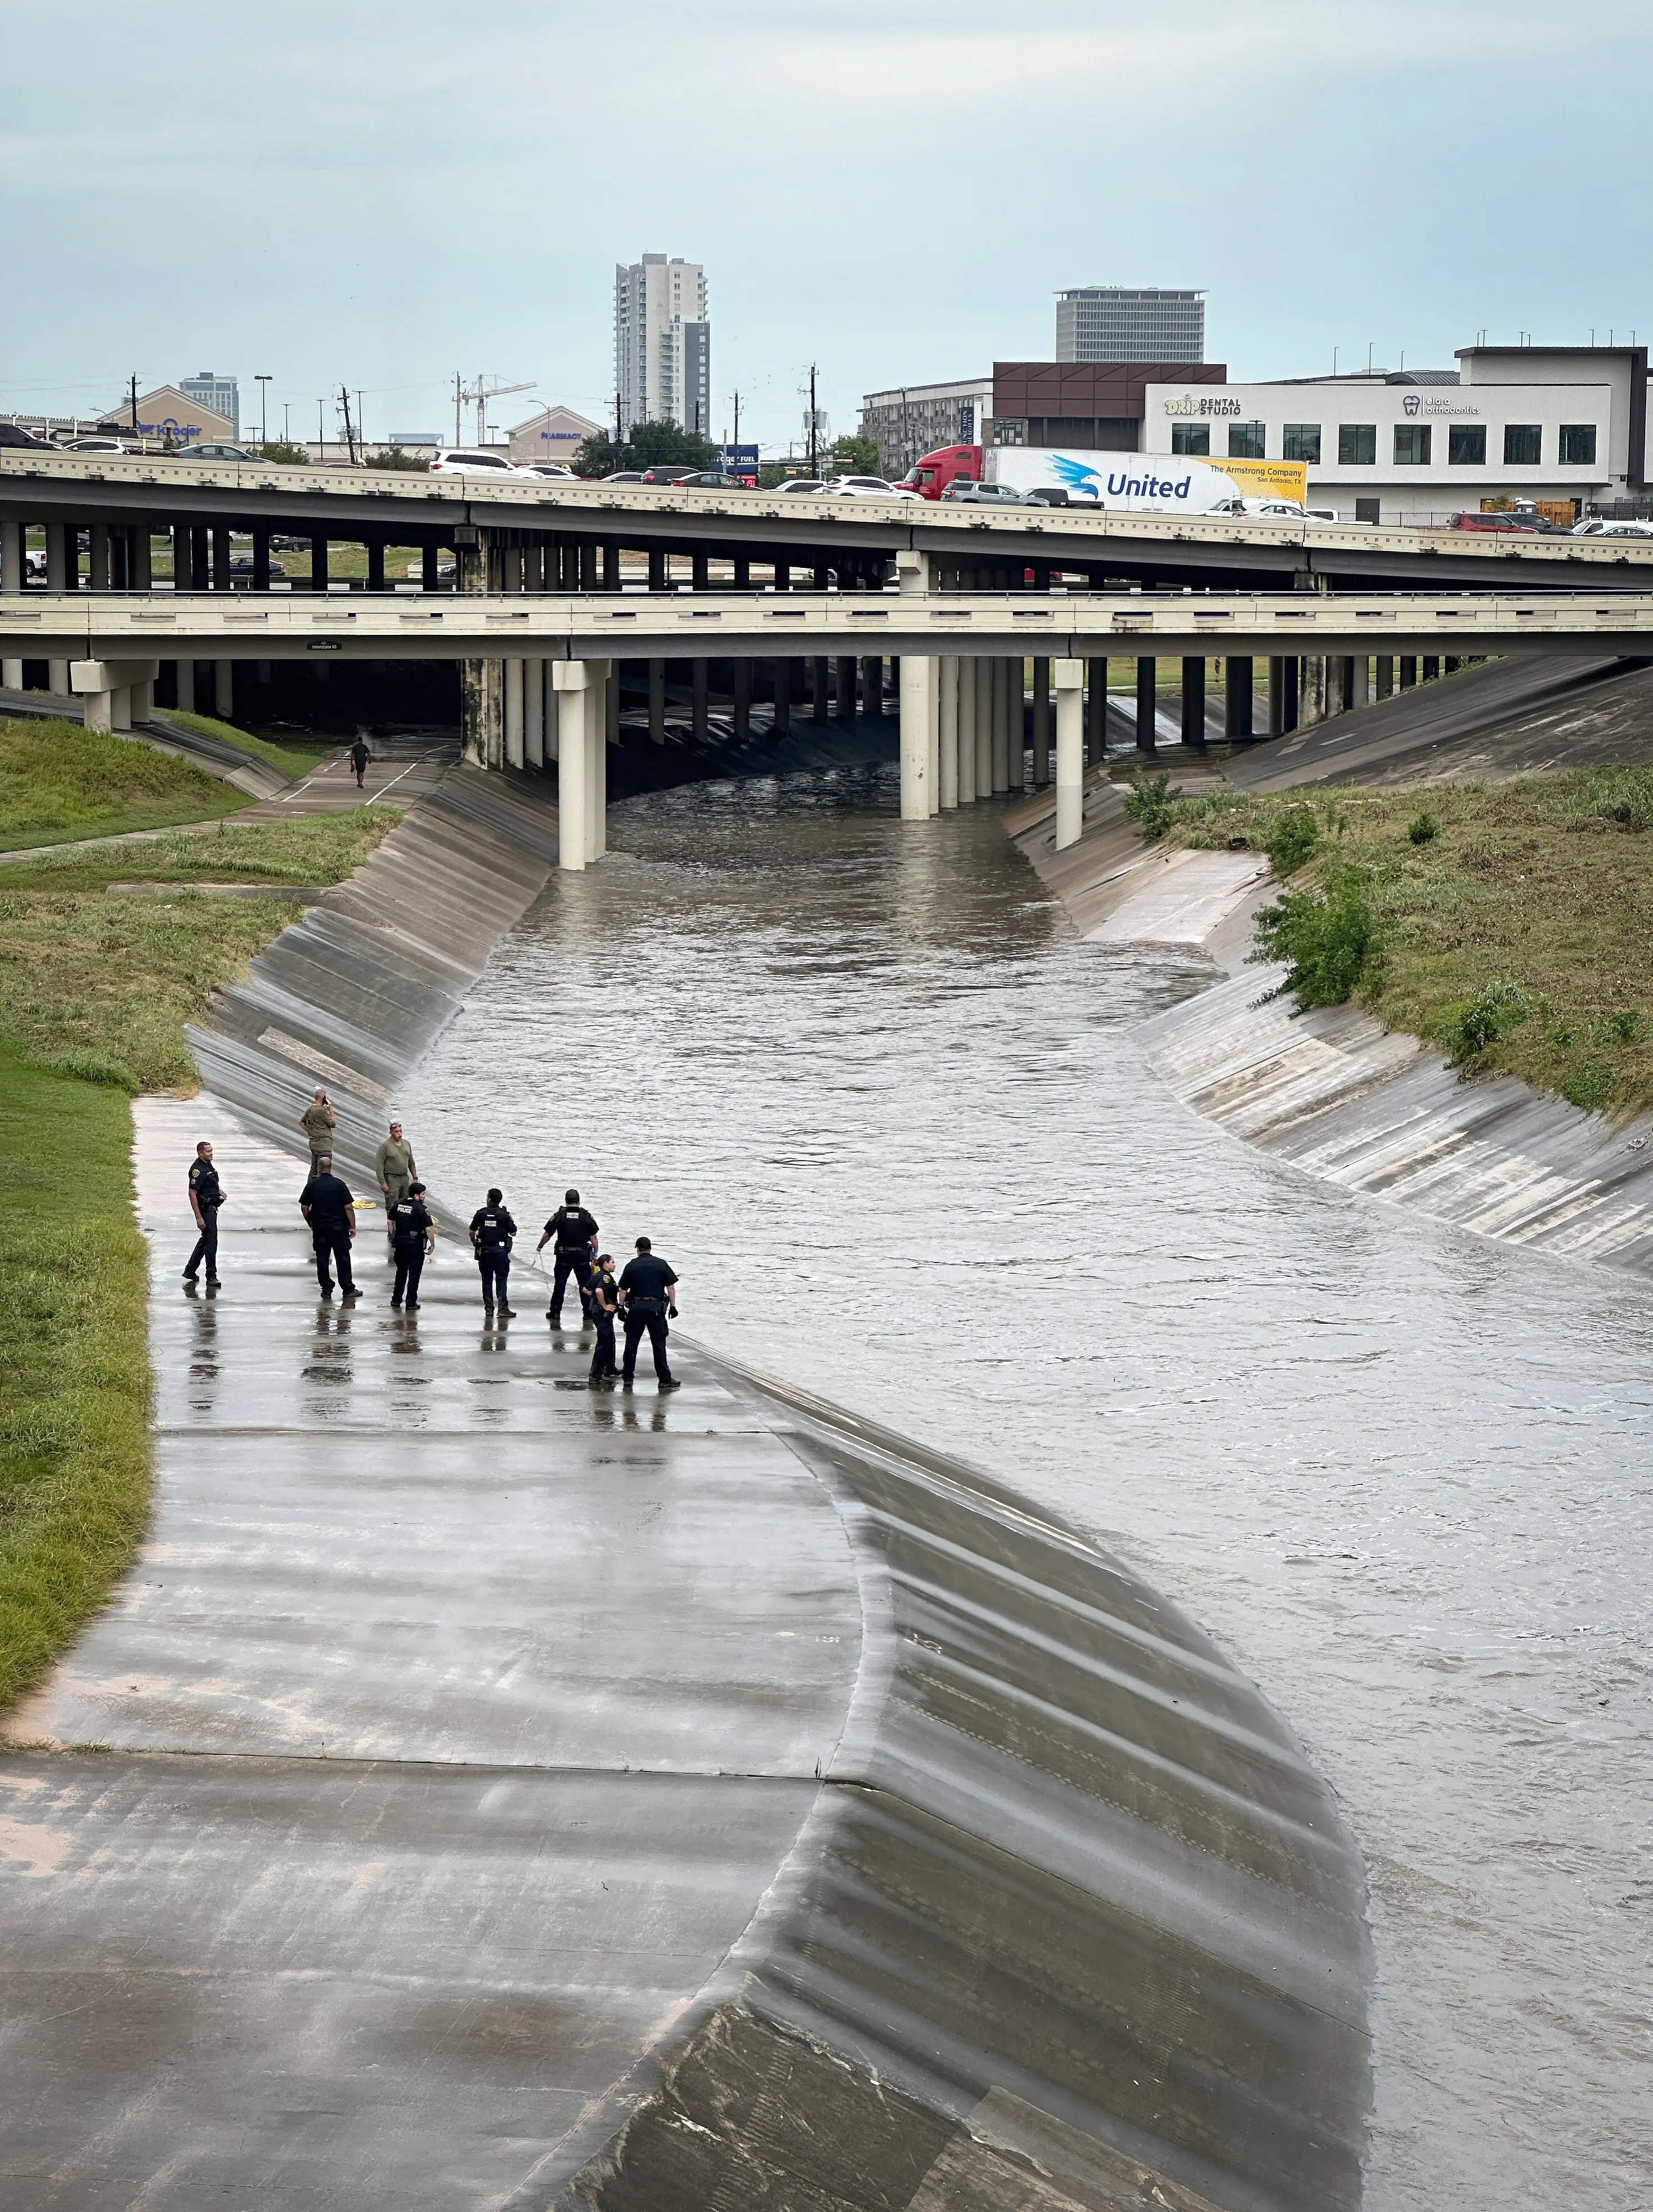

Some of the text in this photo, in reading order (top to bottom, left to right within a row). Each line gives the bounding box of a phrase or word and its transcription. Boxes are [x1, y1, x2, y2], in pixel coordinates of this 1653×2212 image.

[1200, 398, 1241, 407] DENTAL
[1200, 406, 1241, 415] STUDIO
[1427, 406, 1480, 414] orthodontics
[157, 418, 202, 443] Koger
[1226, 467, 1265, 476] Armstrong
[1267, 468, 1302, 477] Company
[1108, 474, 1191, 499] United
